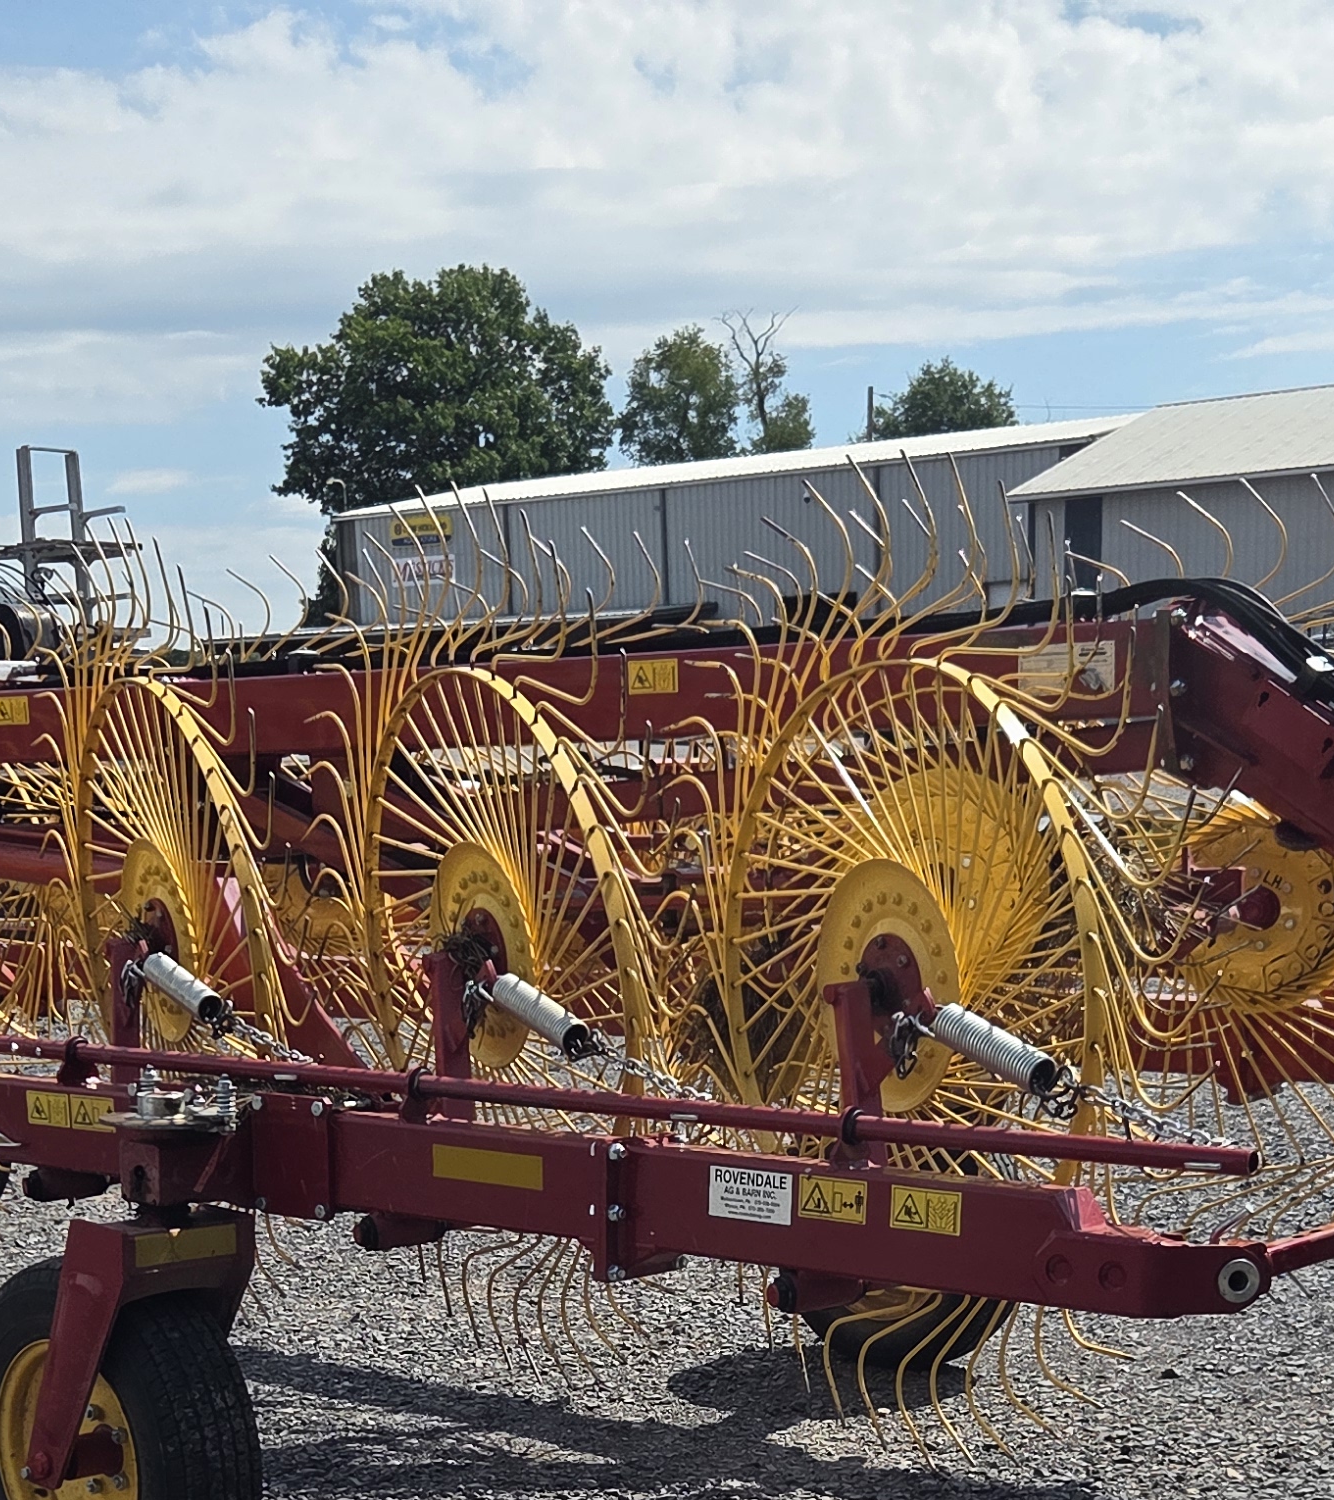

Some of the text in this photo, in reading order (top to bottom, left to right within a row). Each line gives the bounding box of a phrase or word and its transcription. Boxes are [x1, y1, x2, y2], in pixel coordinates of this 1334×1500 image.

[714, 1168, 787, 1190] ROVENDALE
[724, 1185, 777, 1200] AG & BARN INC.
